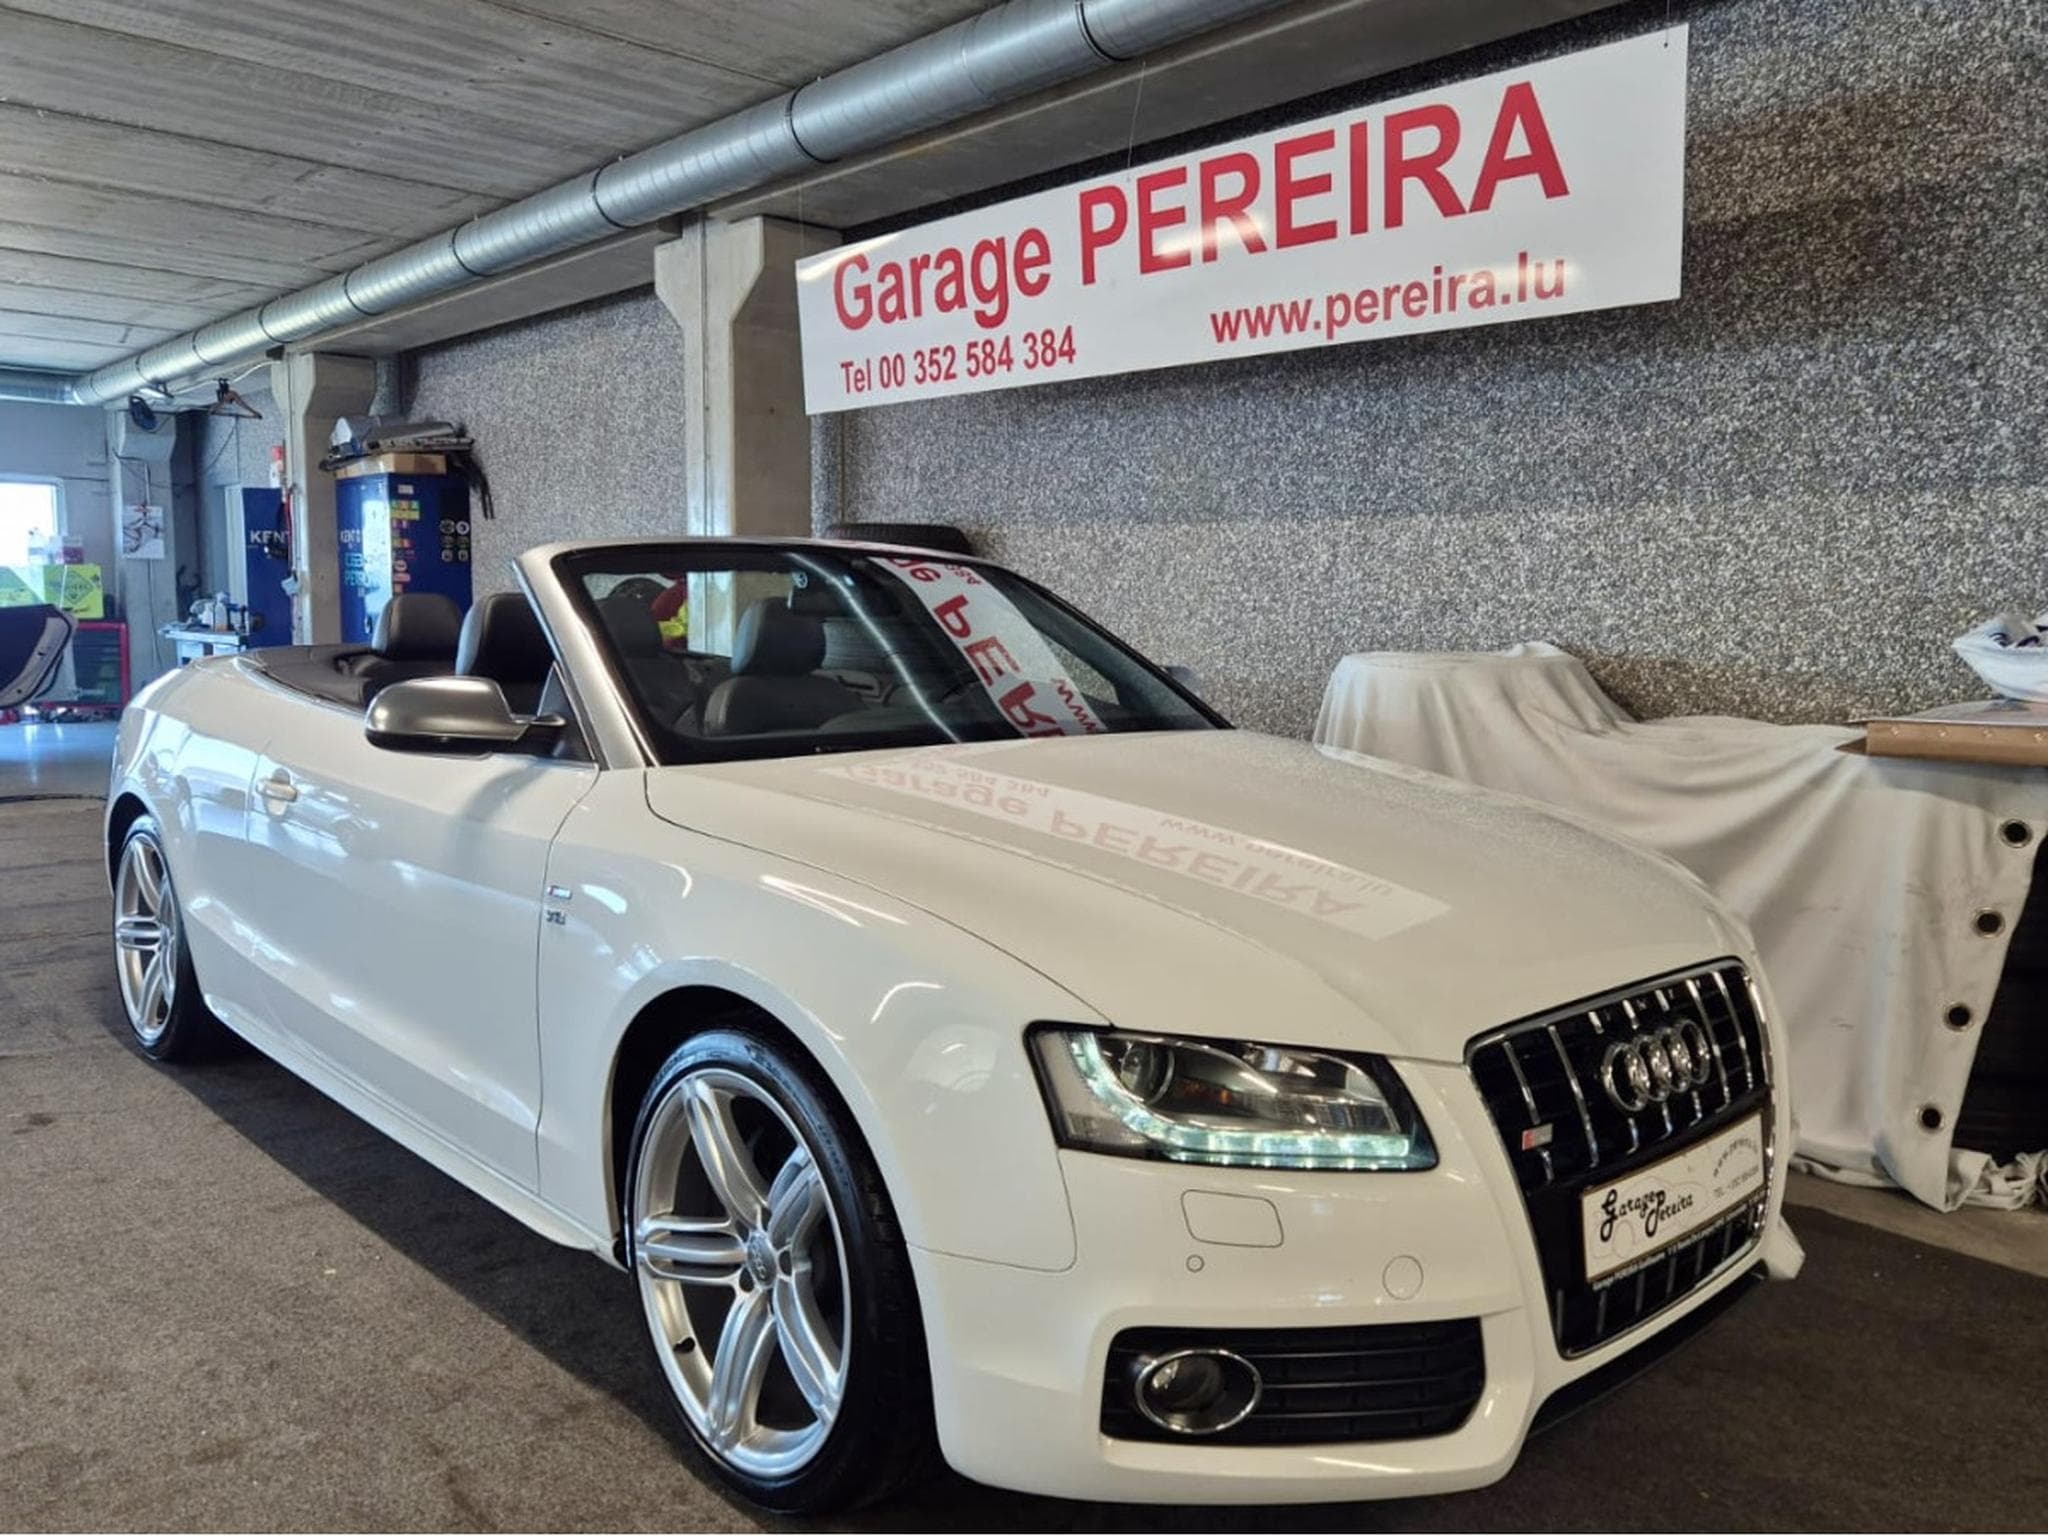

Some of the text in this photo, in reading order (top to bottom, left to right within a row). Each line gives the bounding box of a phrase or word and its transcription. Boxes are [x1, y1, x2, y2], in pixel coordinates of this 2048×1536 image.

[834, 81, 1570, 330] Garage PEREIRA
[1210, 252, 1565, 339] www.pereira.lu
[841, 325, 1075, 394] Tel 00 352 584 384
